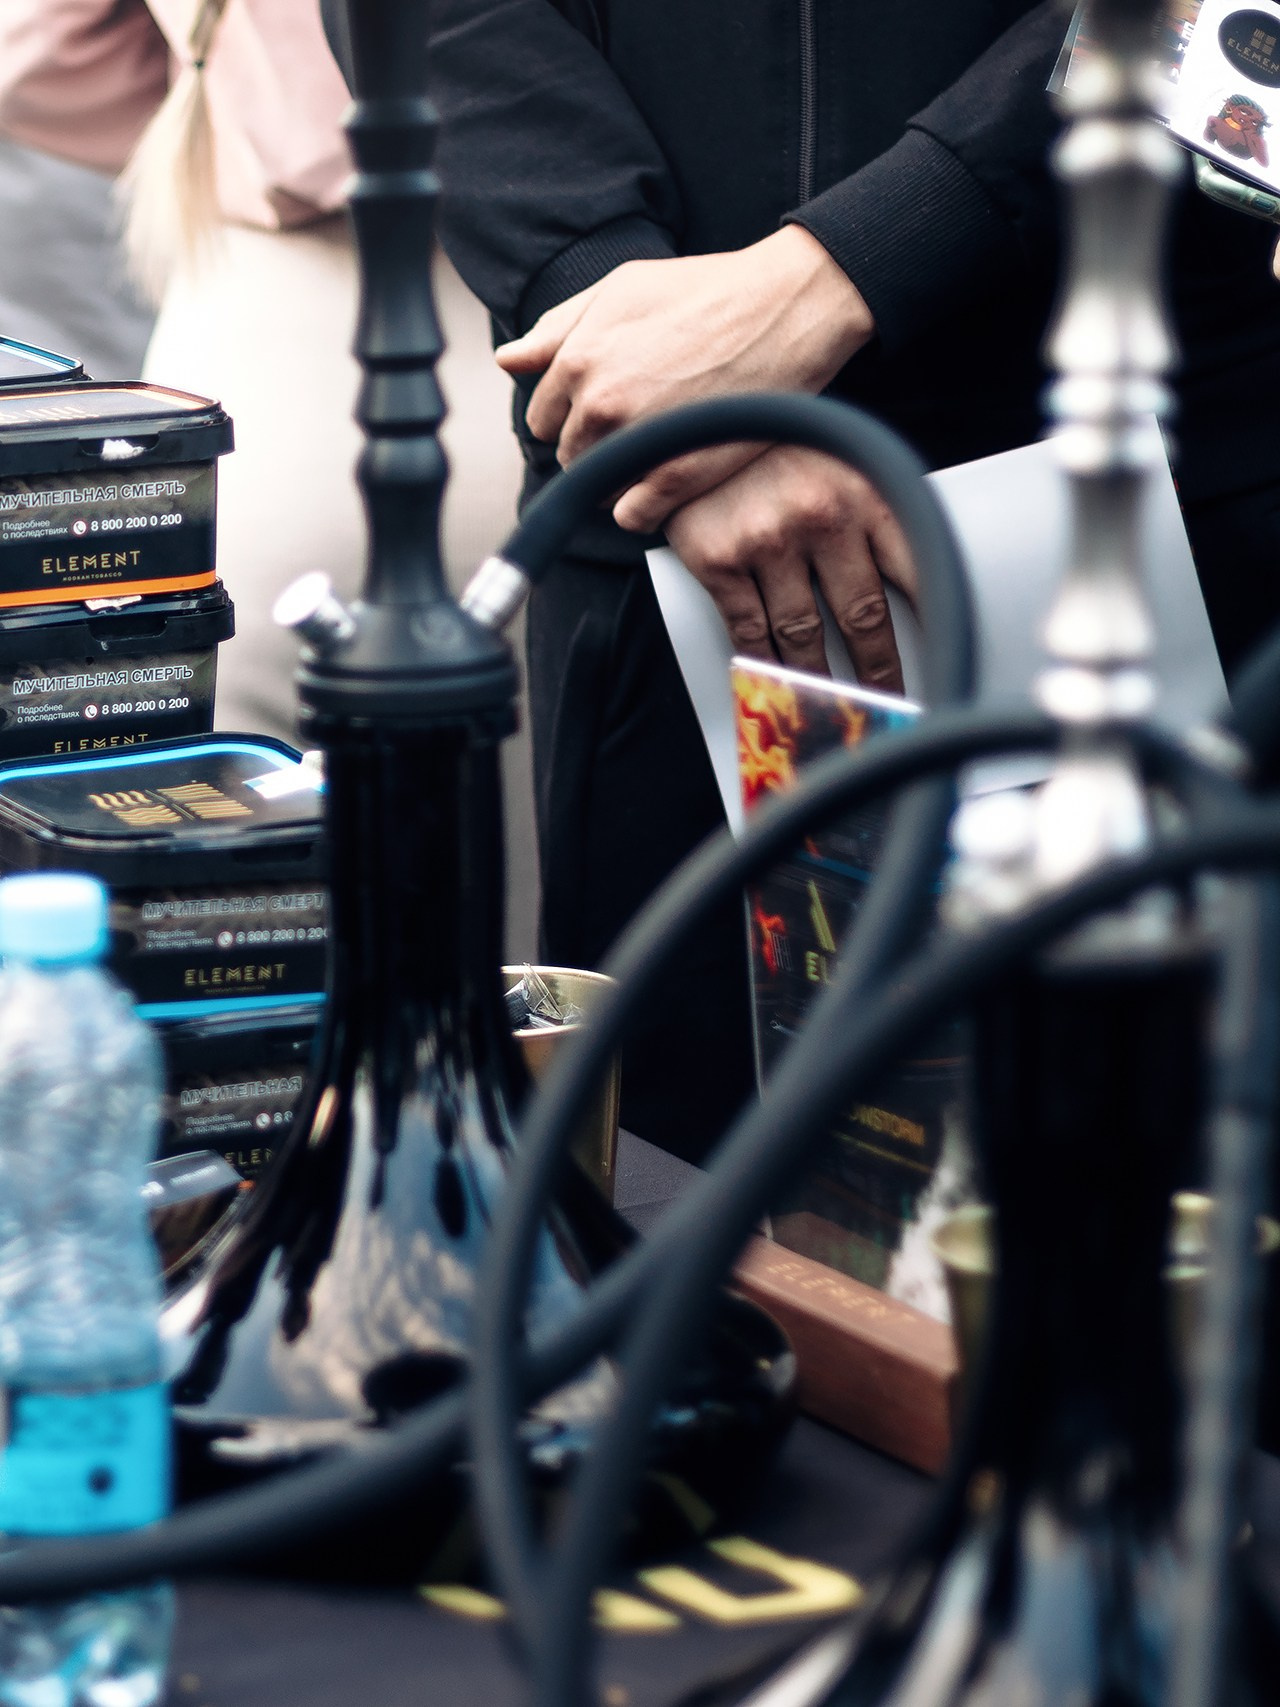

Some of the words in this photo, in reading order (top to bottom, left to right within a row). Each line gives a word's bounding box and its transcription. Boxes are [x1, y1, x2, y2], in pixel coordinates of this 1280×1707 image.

[1227, 37, 1280, 72] ELEMEN
[120, 480, 187, 499] СМЕРТЬ
[2, 519, 51, 531] Подробнее
[90, 520, 99, 531] 8
[101, 518, 123, 531] 800
[125, 516, 148, 529] 200
[150, 515, 158, 527] 0
[160, 513, 183, 526] 200
[2, 532, 9, 540] о
[10, 526, 68, 540] последствиях
[42, 550, 141, 575] ELEMENT
[90, 571, 123, 580] TOBACCO
[12, 671, 129, 695] МУЧИТЕЛЬНАЯ
[131, 665, 194, 683] СМЕРТЬ
[17, 704, 64, 716] Подробнее
[101, 704, 110, 715] 8
[112, 702, 133, 714] 800
[135, 700, 156, 713] 200
[158, 699, 166, 710] 0
[168, 697, 189, 709] 200
[24, 711, 80, 724] последствиях
[142, 895, 268, 921] МУЧИТЕЛЬНАЯ
[269, 892, 325, 912] СМЕРТ
[236, 931, 246, 945] 8
[247, 930, 270, 944] 800
[271, 928, 295, 943] 200
[296, 927, 306, 940] 0
[184, 963, 287, 986] ELEMENT
[180, 1075, 303, 1107] МУЧИТЕЛЬНАЯ
